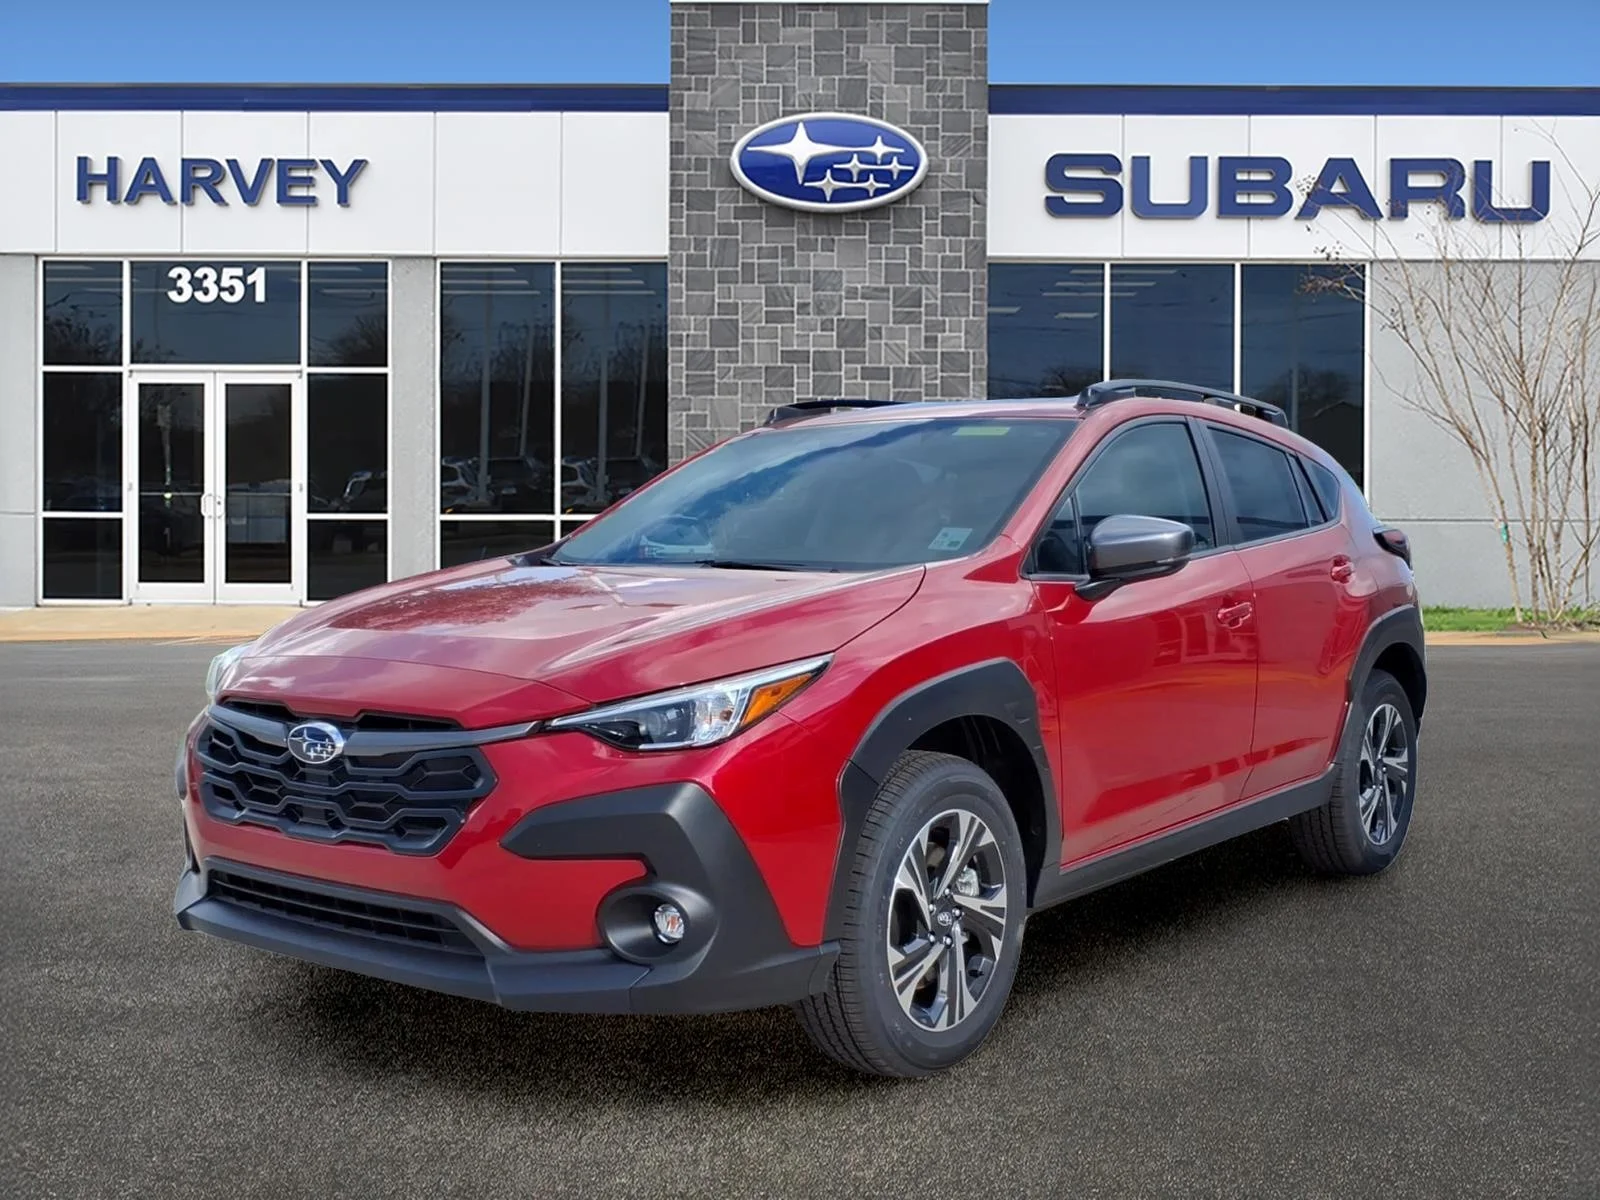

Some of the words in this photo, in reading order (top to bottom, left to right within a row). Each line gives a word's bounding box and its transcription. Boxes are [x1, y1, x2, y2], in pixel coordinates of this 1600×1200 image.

[76, 156, 367, 207] HARVEY
[1045, 153, 1551, 222] SUBARU
[167, 266, 267, 303] 3351
